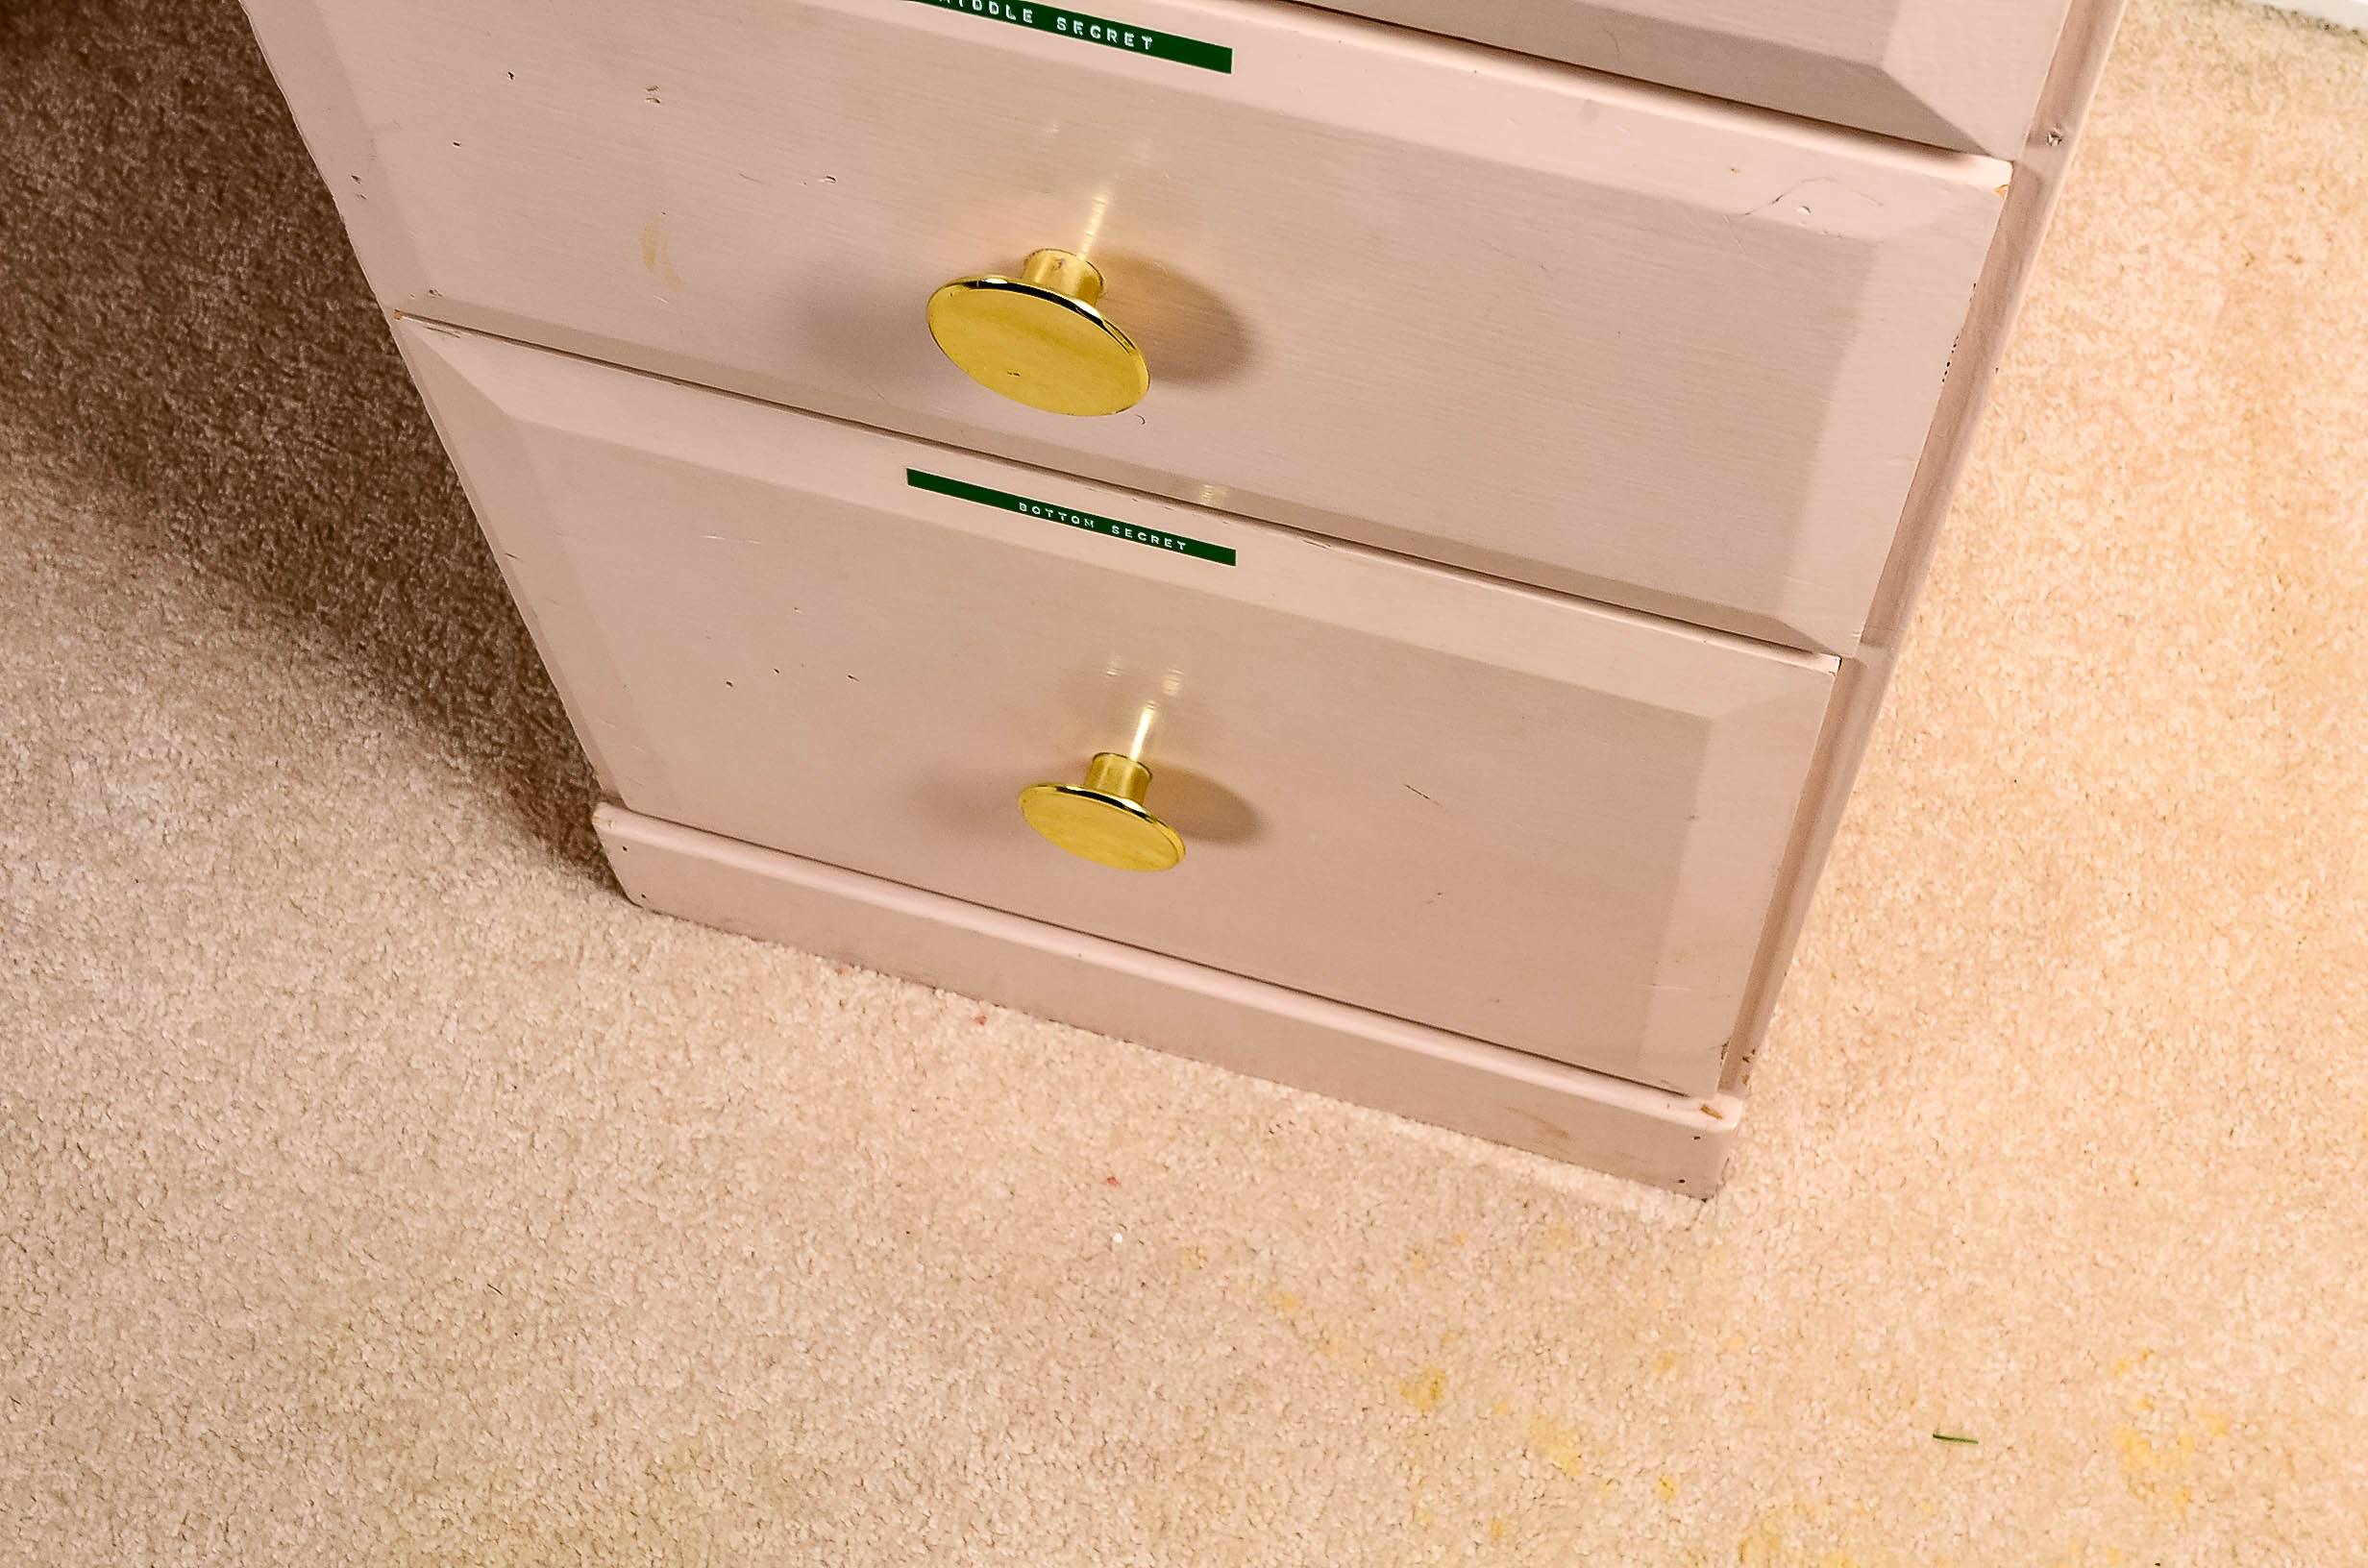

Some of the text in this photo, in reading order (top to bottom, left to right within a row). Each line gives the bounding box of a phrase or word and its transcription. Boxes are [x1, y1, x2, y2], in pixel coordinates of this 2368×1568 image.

[939, 0, 1153, 50] IDDLE SECRET
[1019, 502, 1187, 551] BOTTOM SECRET
